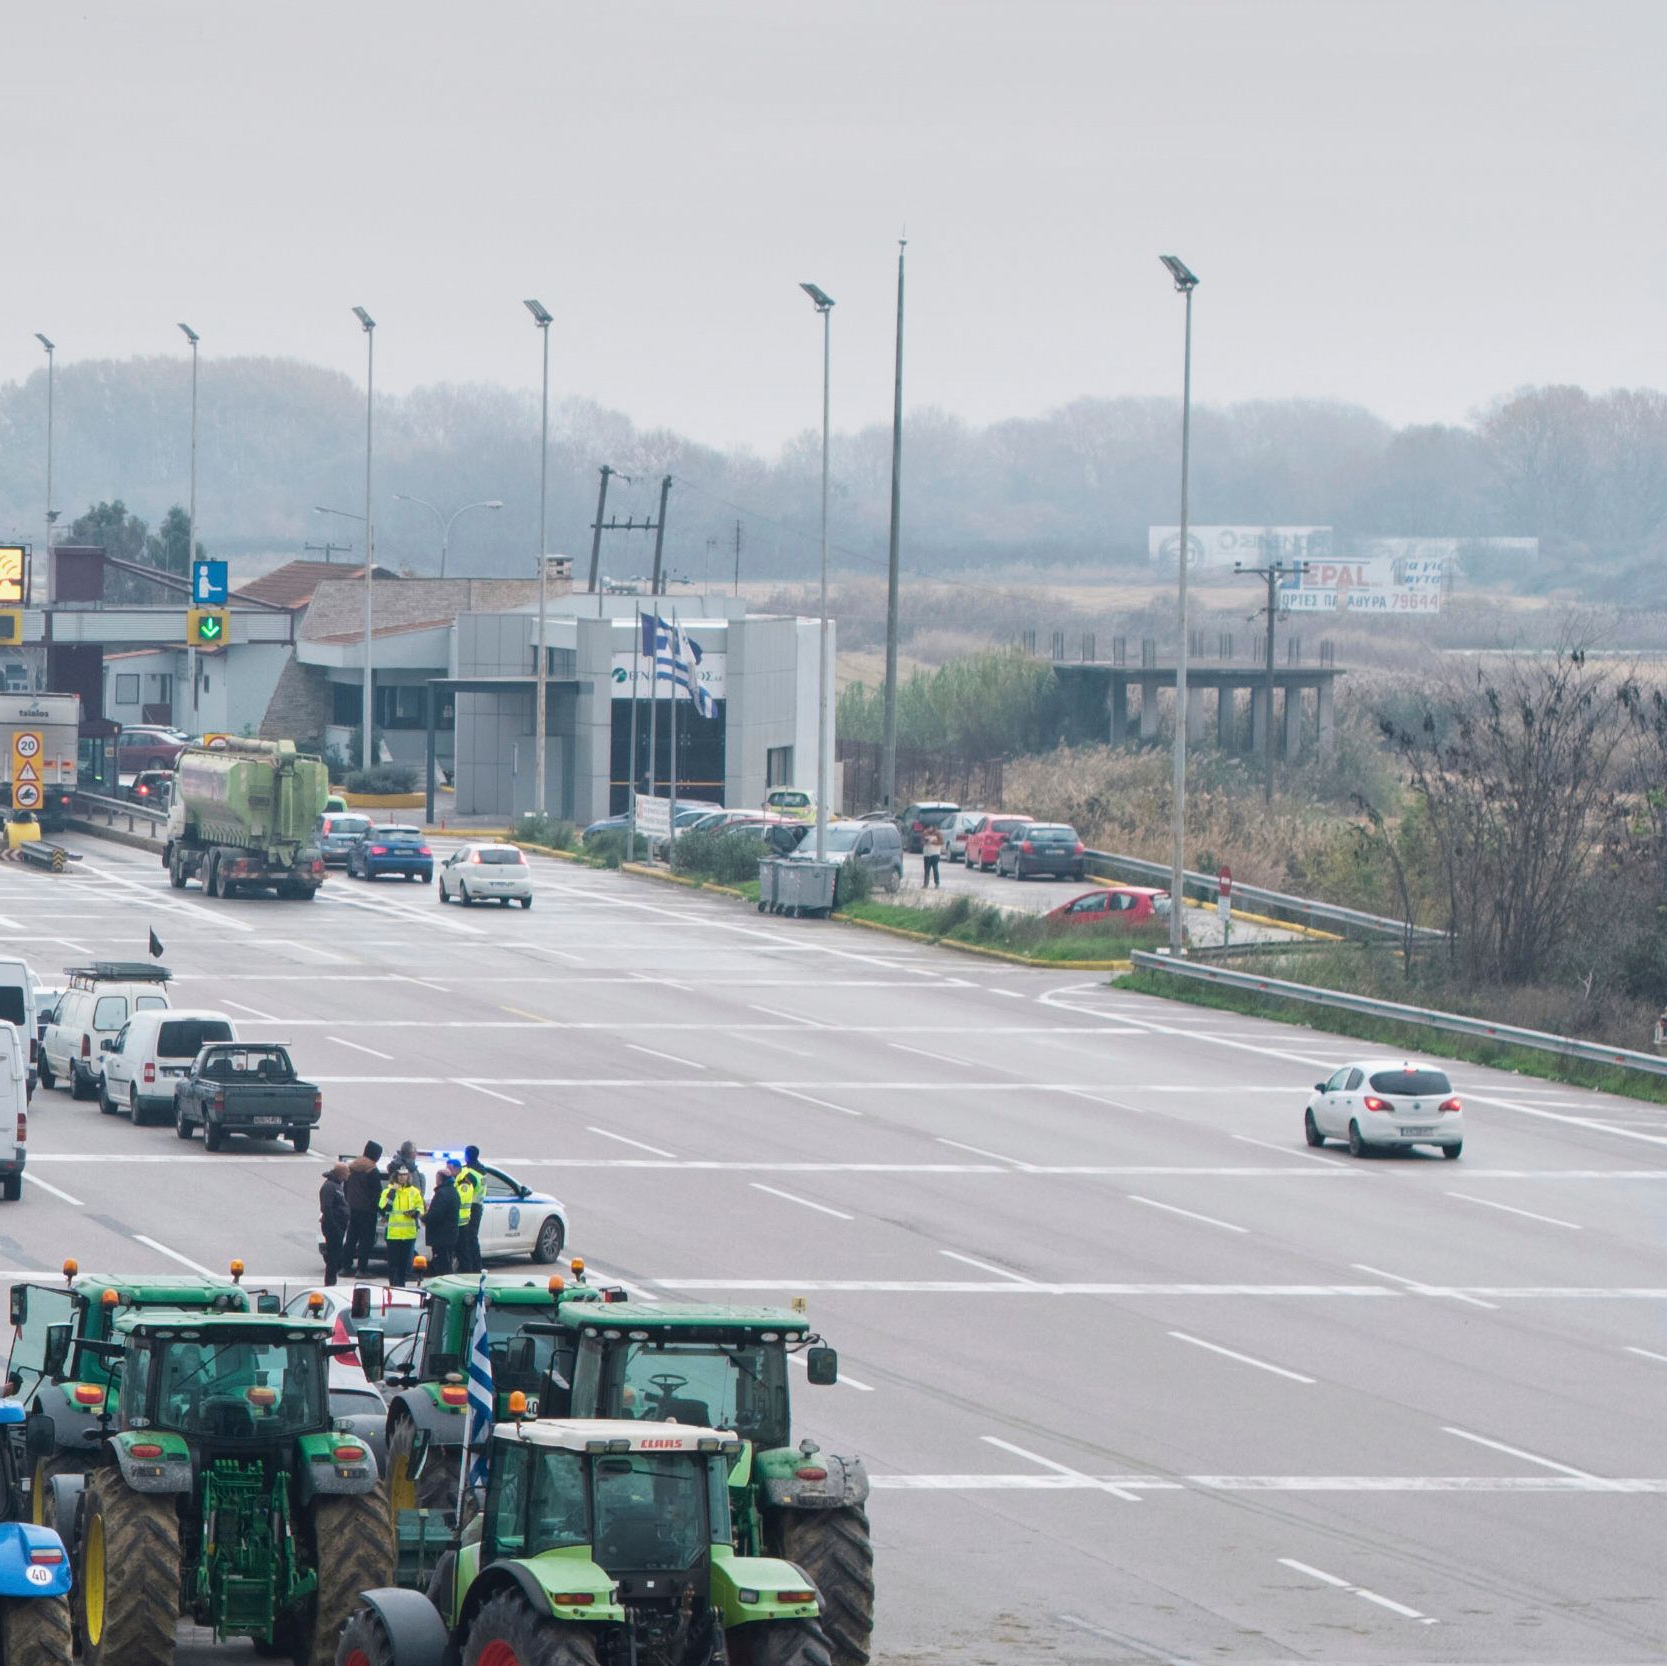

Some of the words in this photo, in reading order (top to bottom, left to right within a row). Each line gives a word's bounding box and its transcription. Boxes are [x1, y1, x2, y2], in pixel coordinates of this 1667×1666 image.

[1282, 593, 1317, 606] ΟΡΤΕΣ
[21, 740, 35, 751] 20
[640, 1439, 683, 1449] CLAAS
[31, 1569, 47, 1582] 40
